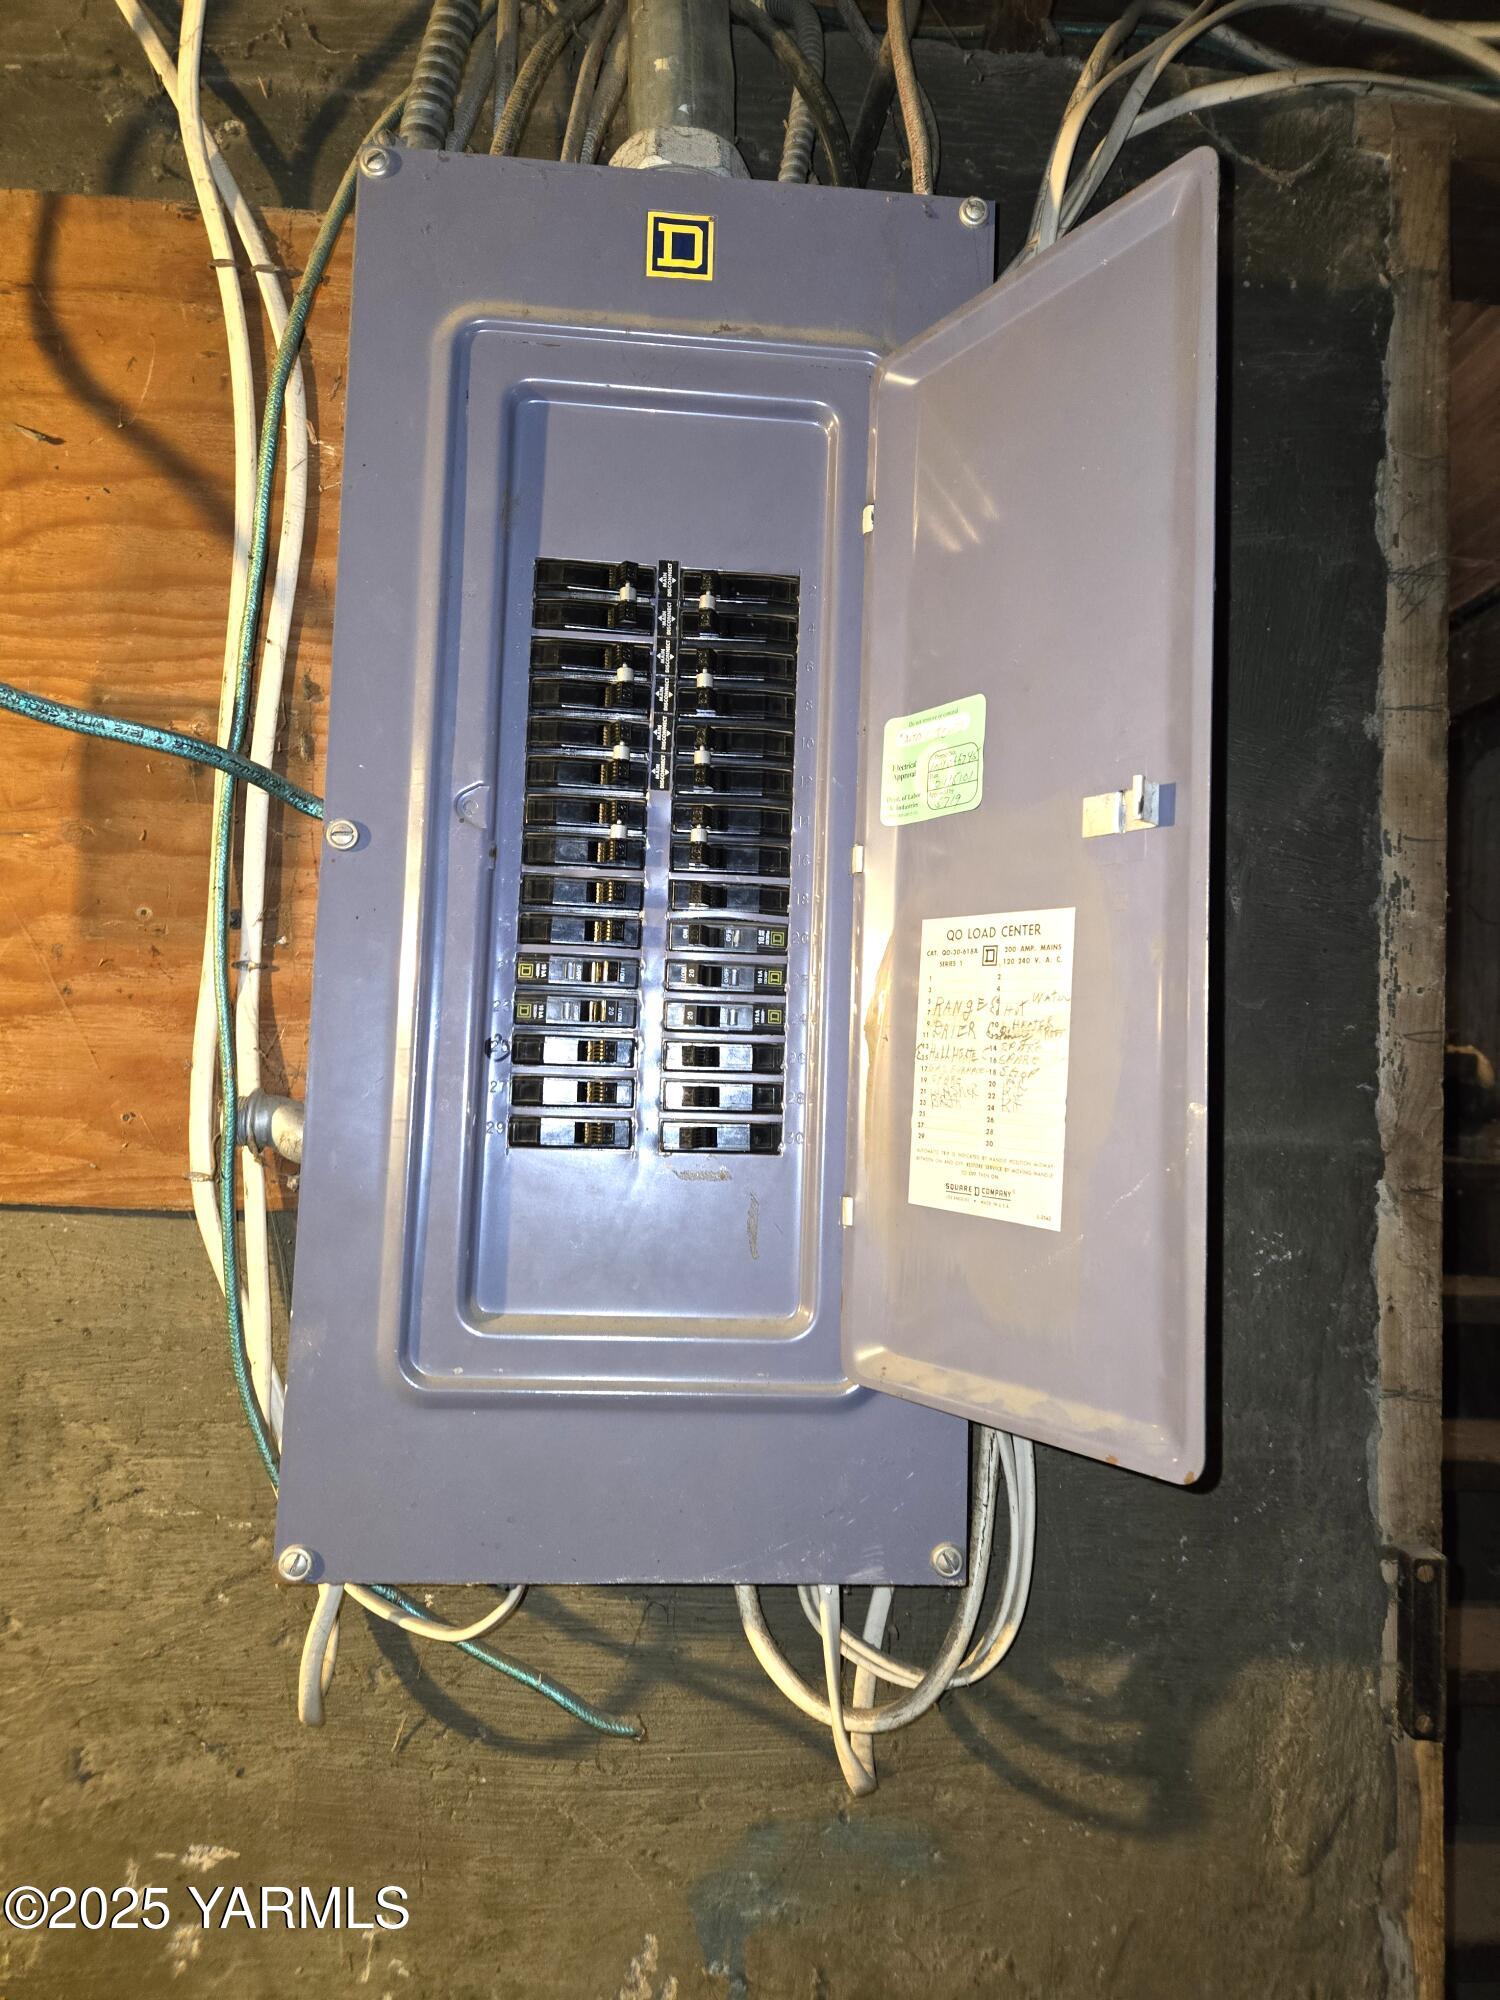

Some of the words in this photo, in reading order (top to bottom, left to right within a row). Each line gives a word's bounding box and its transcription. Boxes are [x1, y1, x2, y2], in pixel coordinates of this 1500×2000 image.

[946, 929, 963, 941] QO
[967, 926, 996, 940] LOAD
[1001, 923, 1042, 937] CENTER
[1040, 943, 1062, 951] MAINS
[688, 968, 695, 978] 20
[608, 1006, 615, 1016] 20
[687, 1011, 694, 1020] 20
[945, 1182, 972, 1193] SQUARE
[974, 1186, 980, 1196] D
[981, 1187, 1012, 1198] COMPANY
